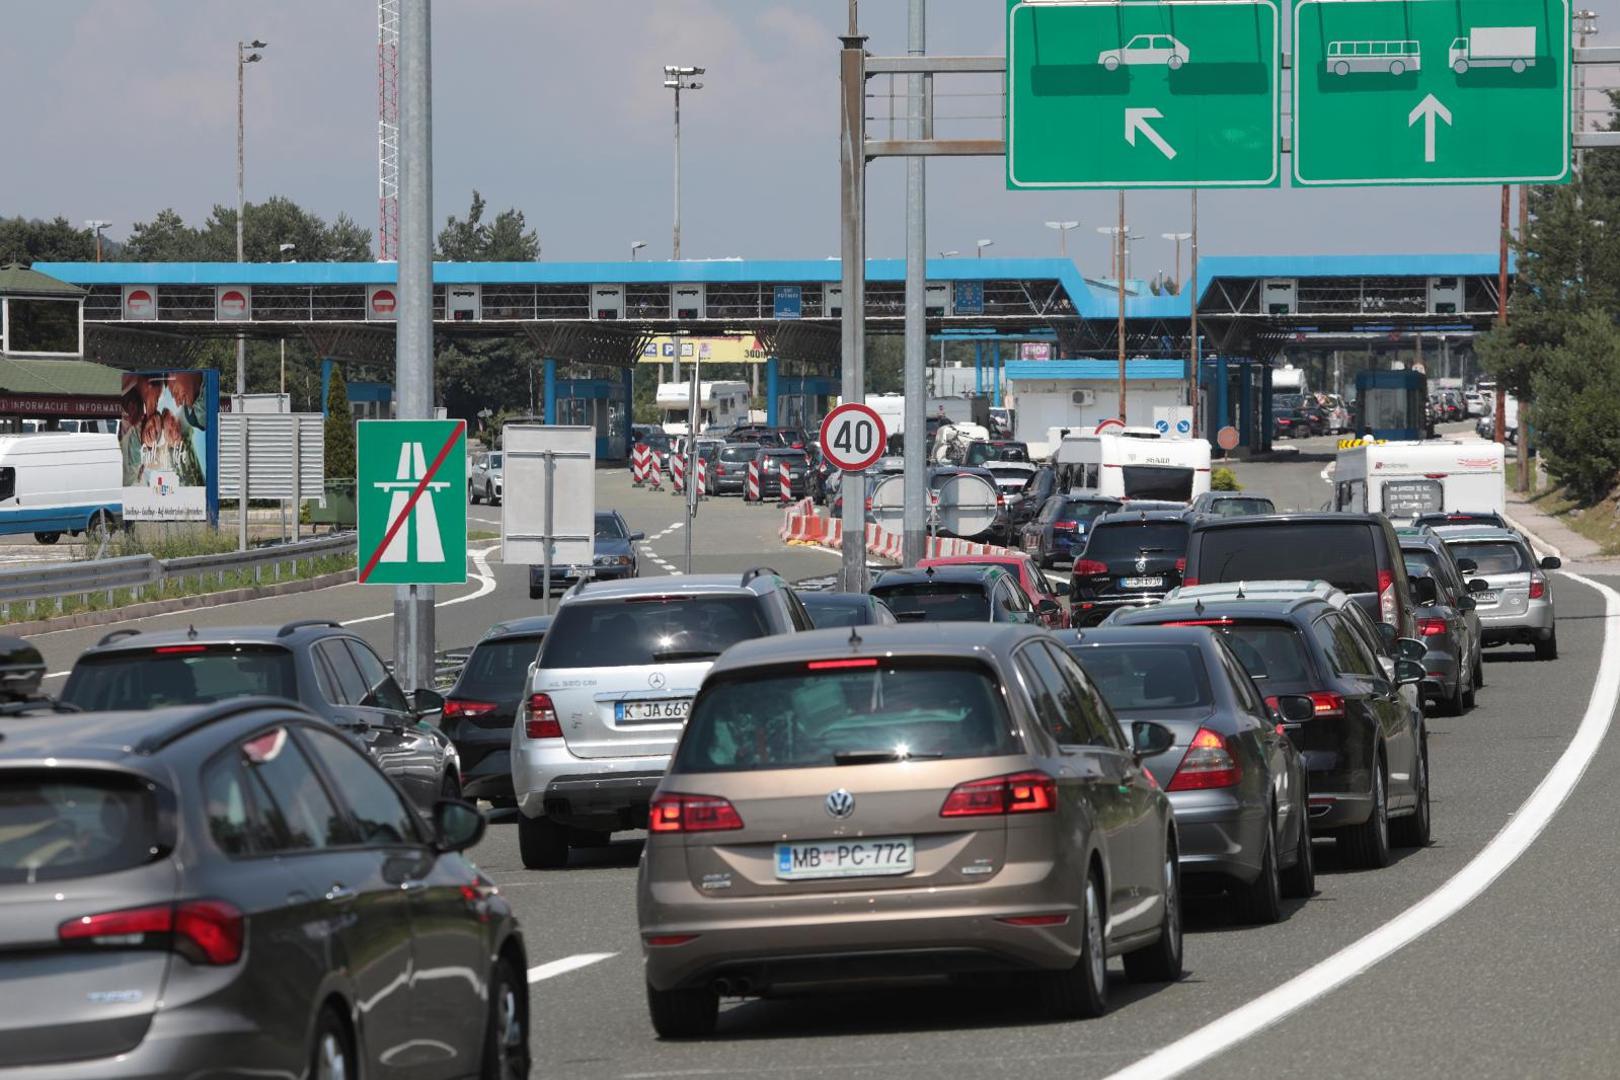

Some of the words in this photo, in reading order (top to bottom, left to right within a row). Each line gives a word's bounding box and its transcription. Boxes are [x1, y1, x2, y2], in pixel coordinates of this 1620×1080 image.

[11, 401, 68, 411] INFORMACIJE
[834, 420, 872, 454] 40
[624, 705, 634, 719] K
[643, 703, 661, 717] JA
[792, 848, 822, 868] MB
[837, 842, 907, 866] PC-772
